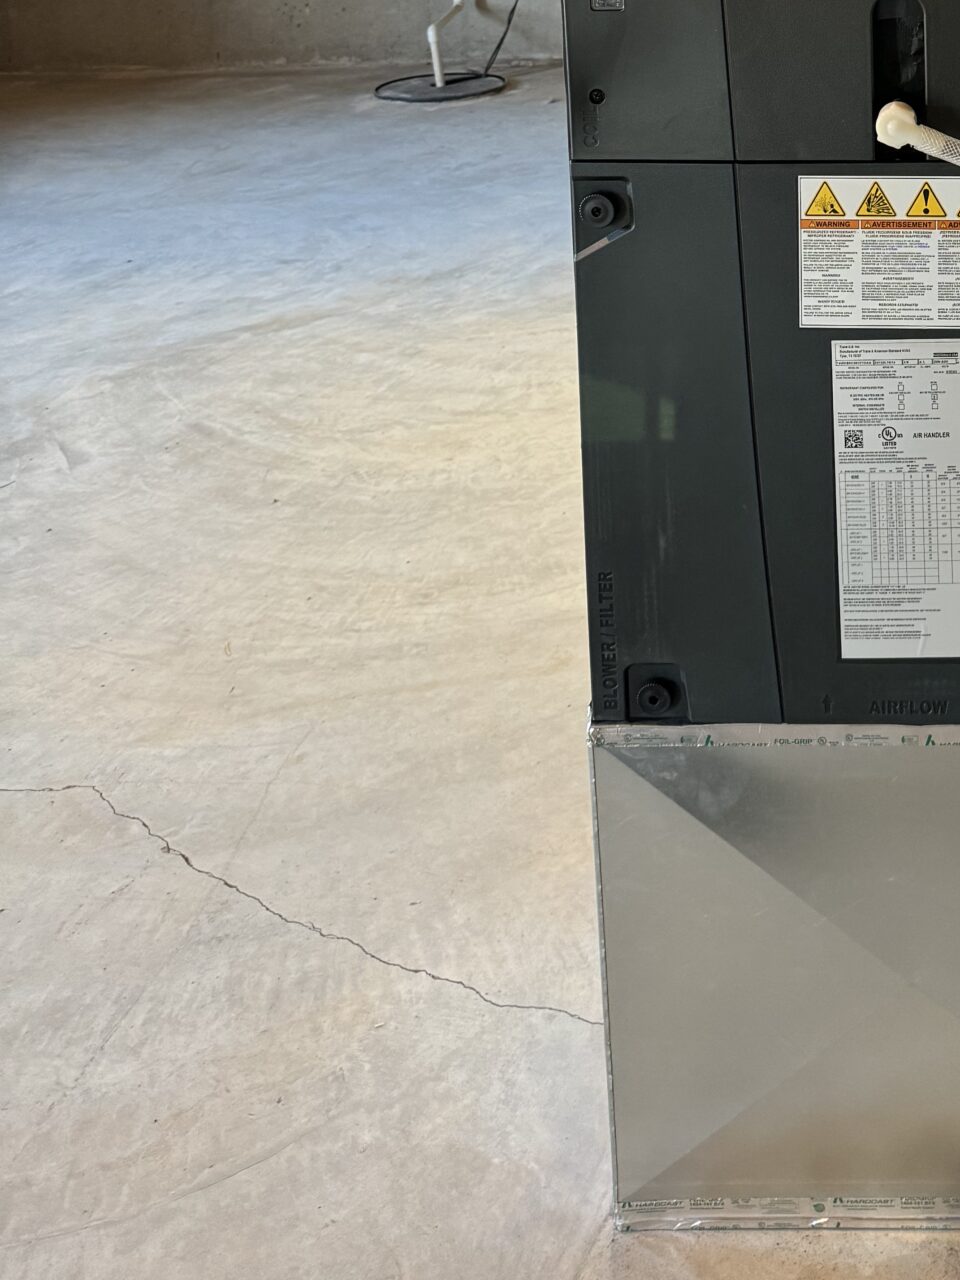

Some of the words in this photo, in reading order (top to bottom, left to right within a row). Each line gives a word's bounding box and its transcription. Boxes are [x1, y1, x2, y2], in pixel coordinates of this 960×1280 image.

[583, 105, 600, 148] COIL
[598, 571, 614, 627] FILTER
[601, 642, 618, 710] BLOWER
[869, 700, 949, 715] AIRFLOW
